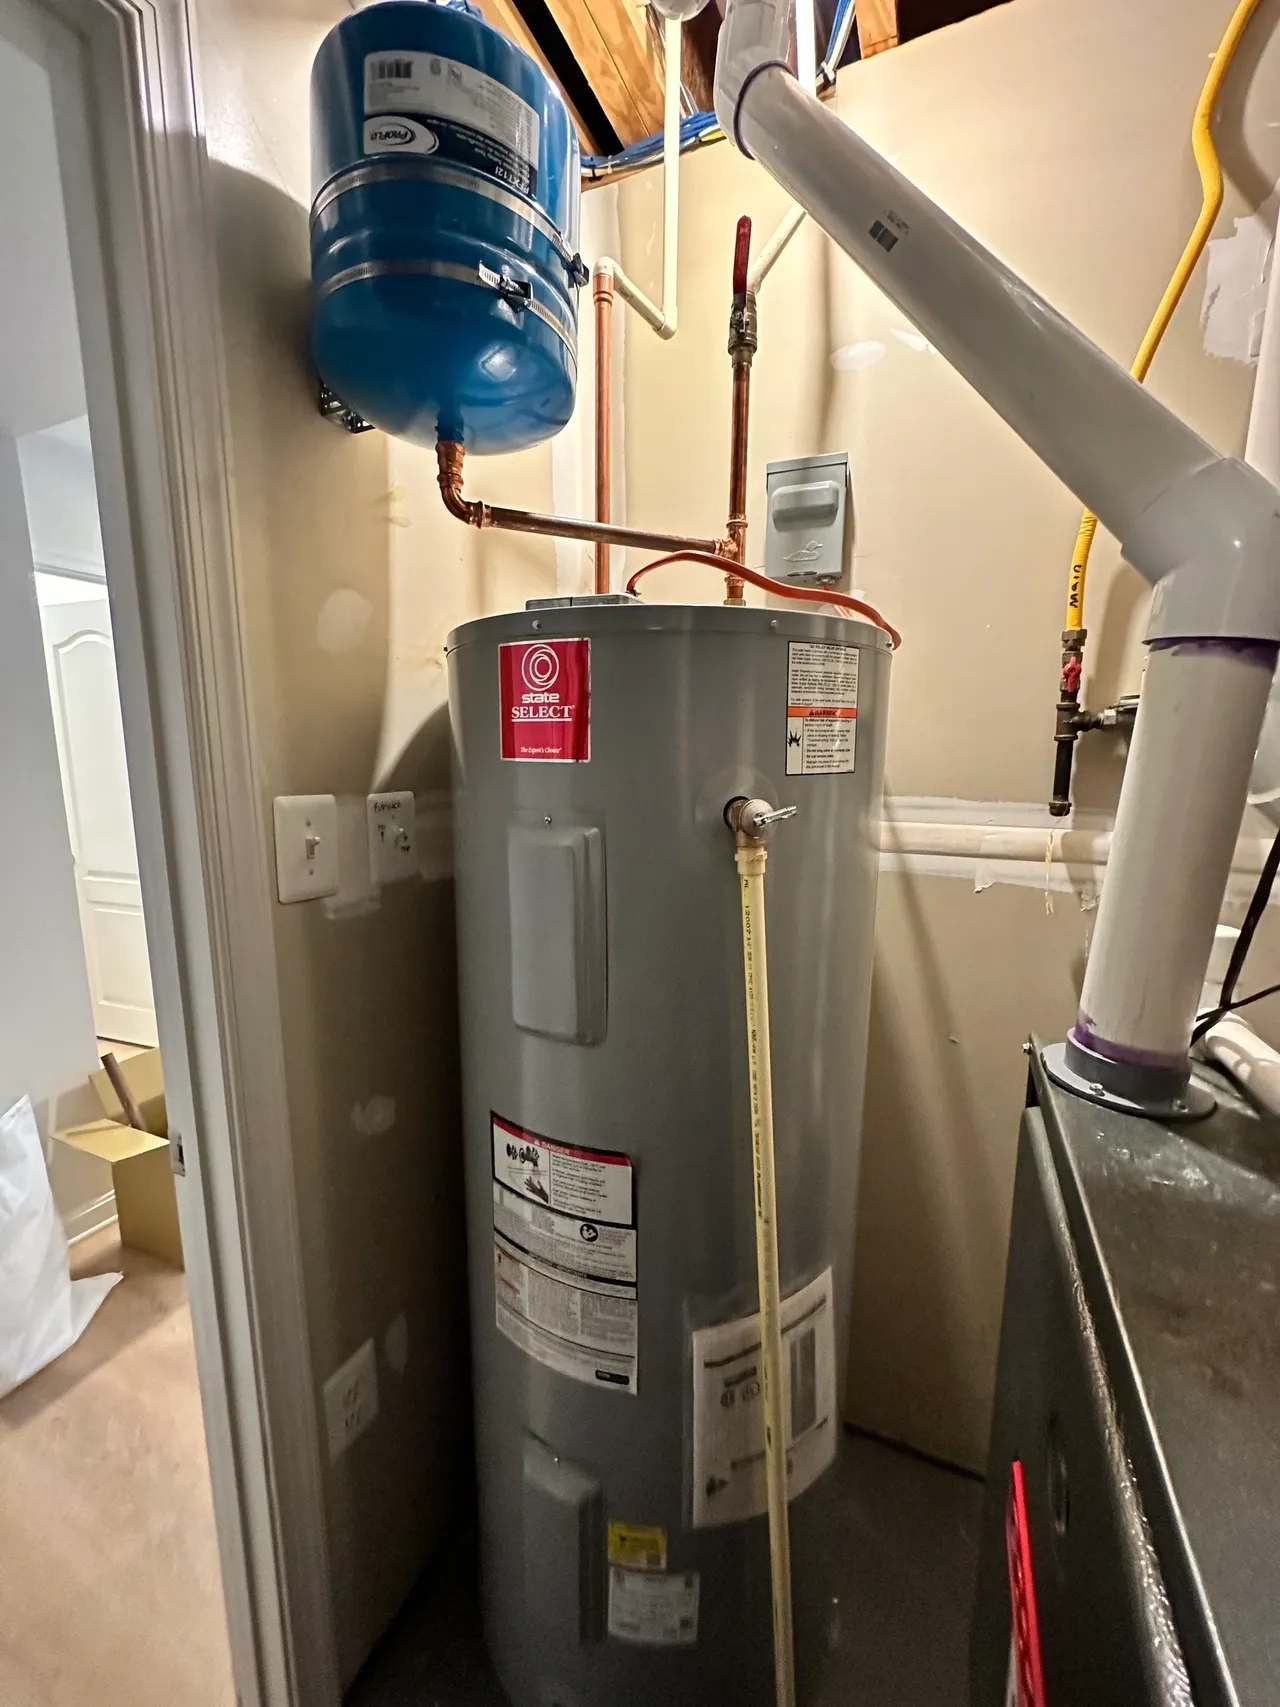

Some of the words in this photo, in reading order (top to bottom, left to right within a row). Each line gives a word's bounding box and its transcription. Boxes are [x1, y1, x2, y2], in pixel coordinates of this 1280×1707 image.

[370, 129, 409, 143] PROFLO
[521, 693, 560, 704] state
[511, 705, 573, 719] SELECT
[815, 709, 840, 717] WARNIN
